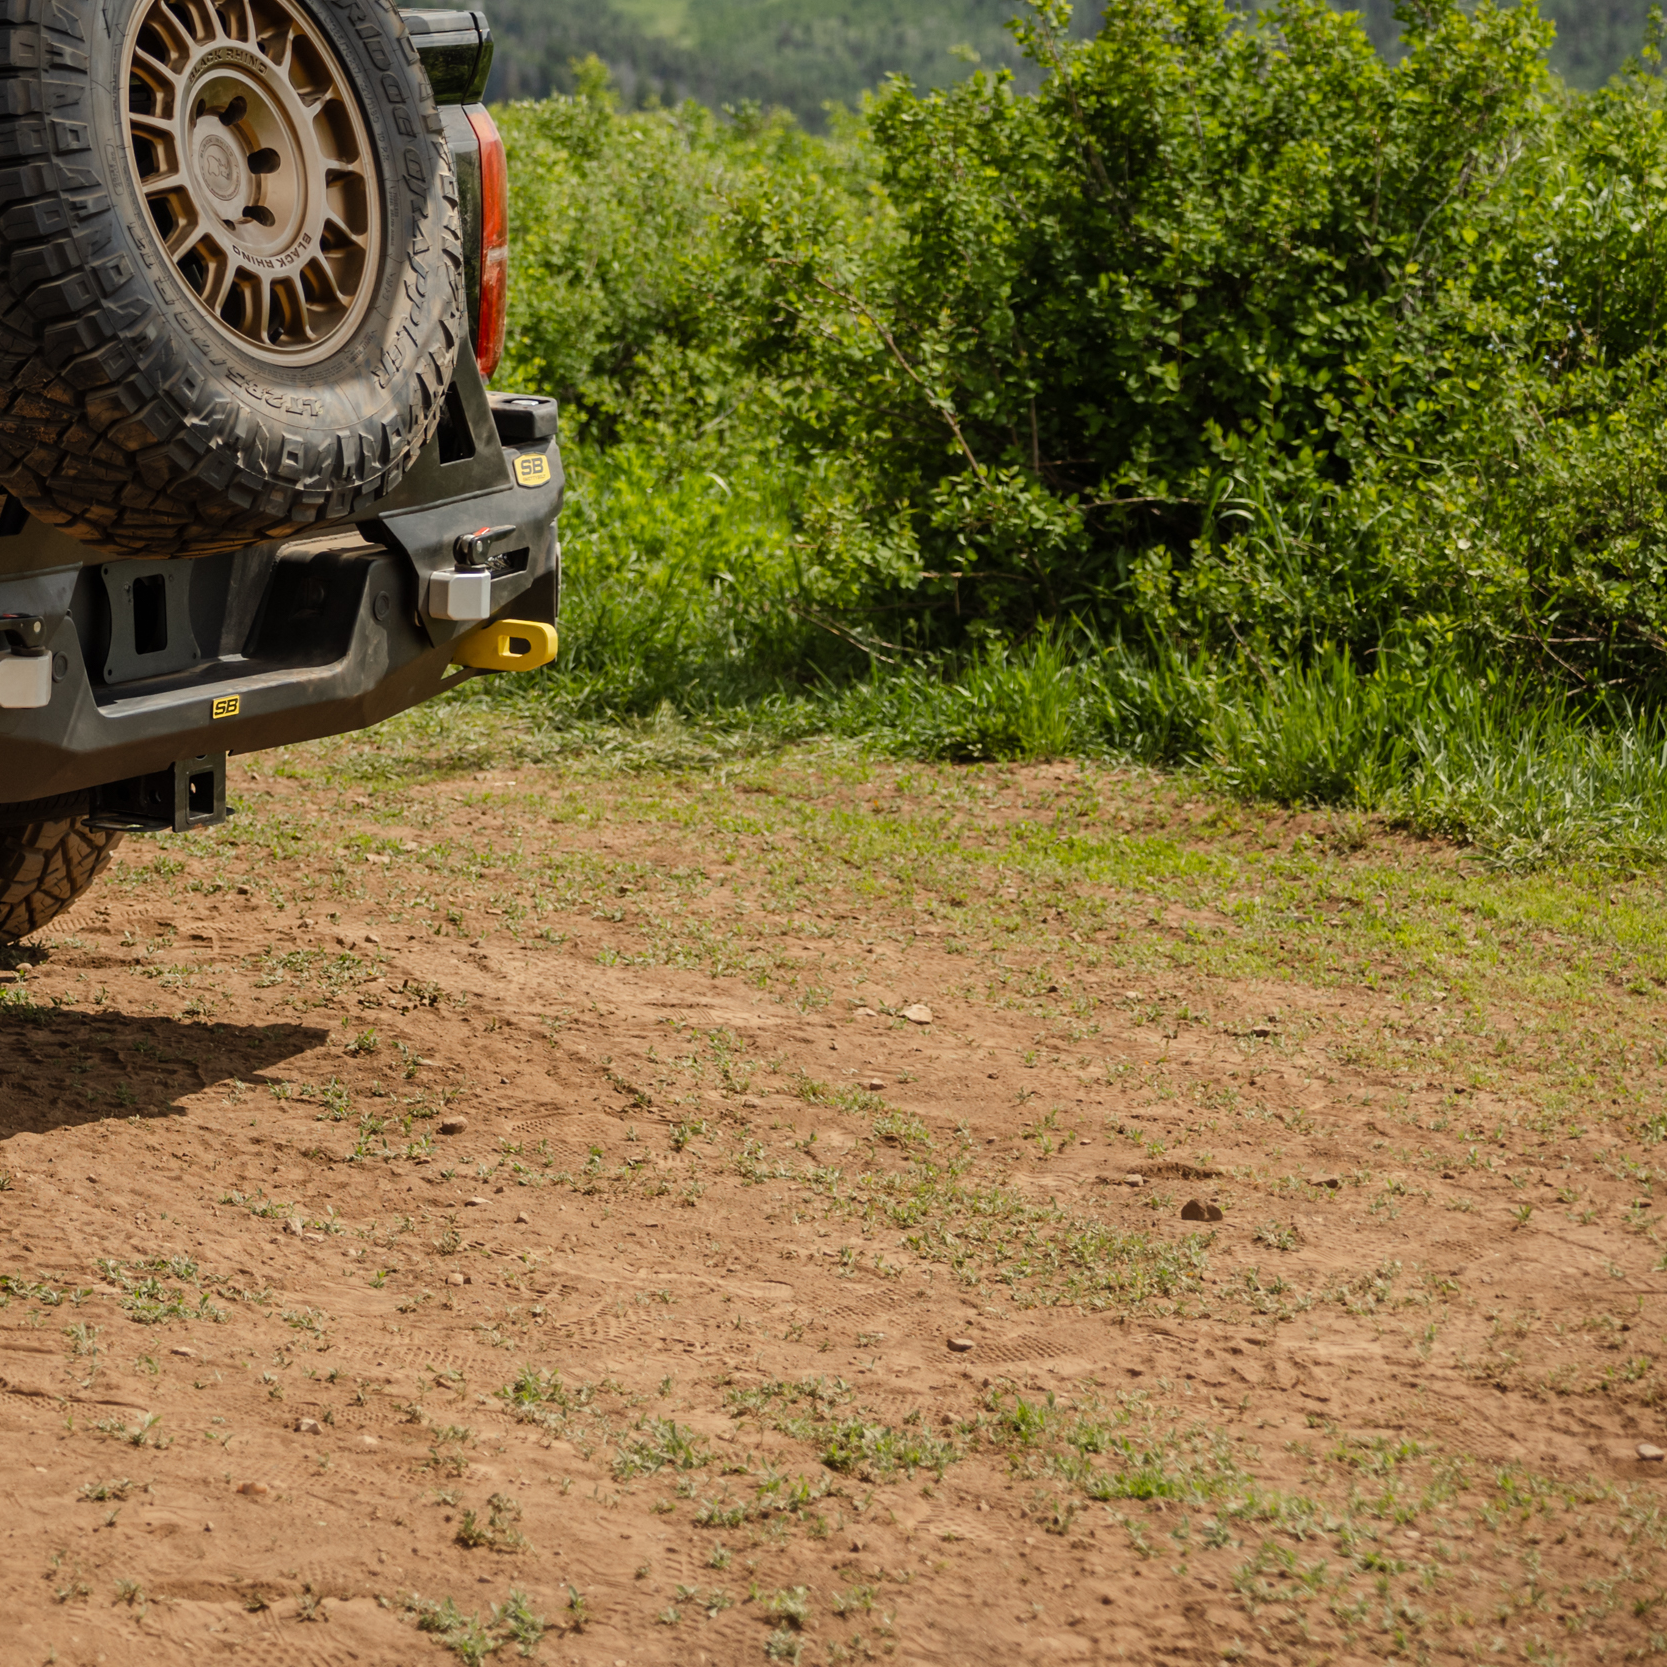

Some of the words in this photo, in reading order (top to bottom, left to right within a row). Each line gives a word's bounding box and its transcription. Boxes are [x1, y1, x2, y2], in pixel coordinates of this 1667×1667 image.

[187, 48, 223, 84] BLACK
[225, 47, 268, 76] RHINO
[231, 242, 277, 270] RHINO
[277, 231, 314, 270] BLACK
[520, 457, 544, 476] SB
[214, 698, 238, 716] SB
